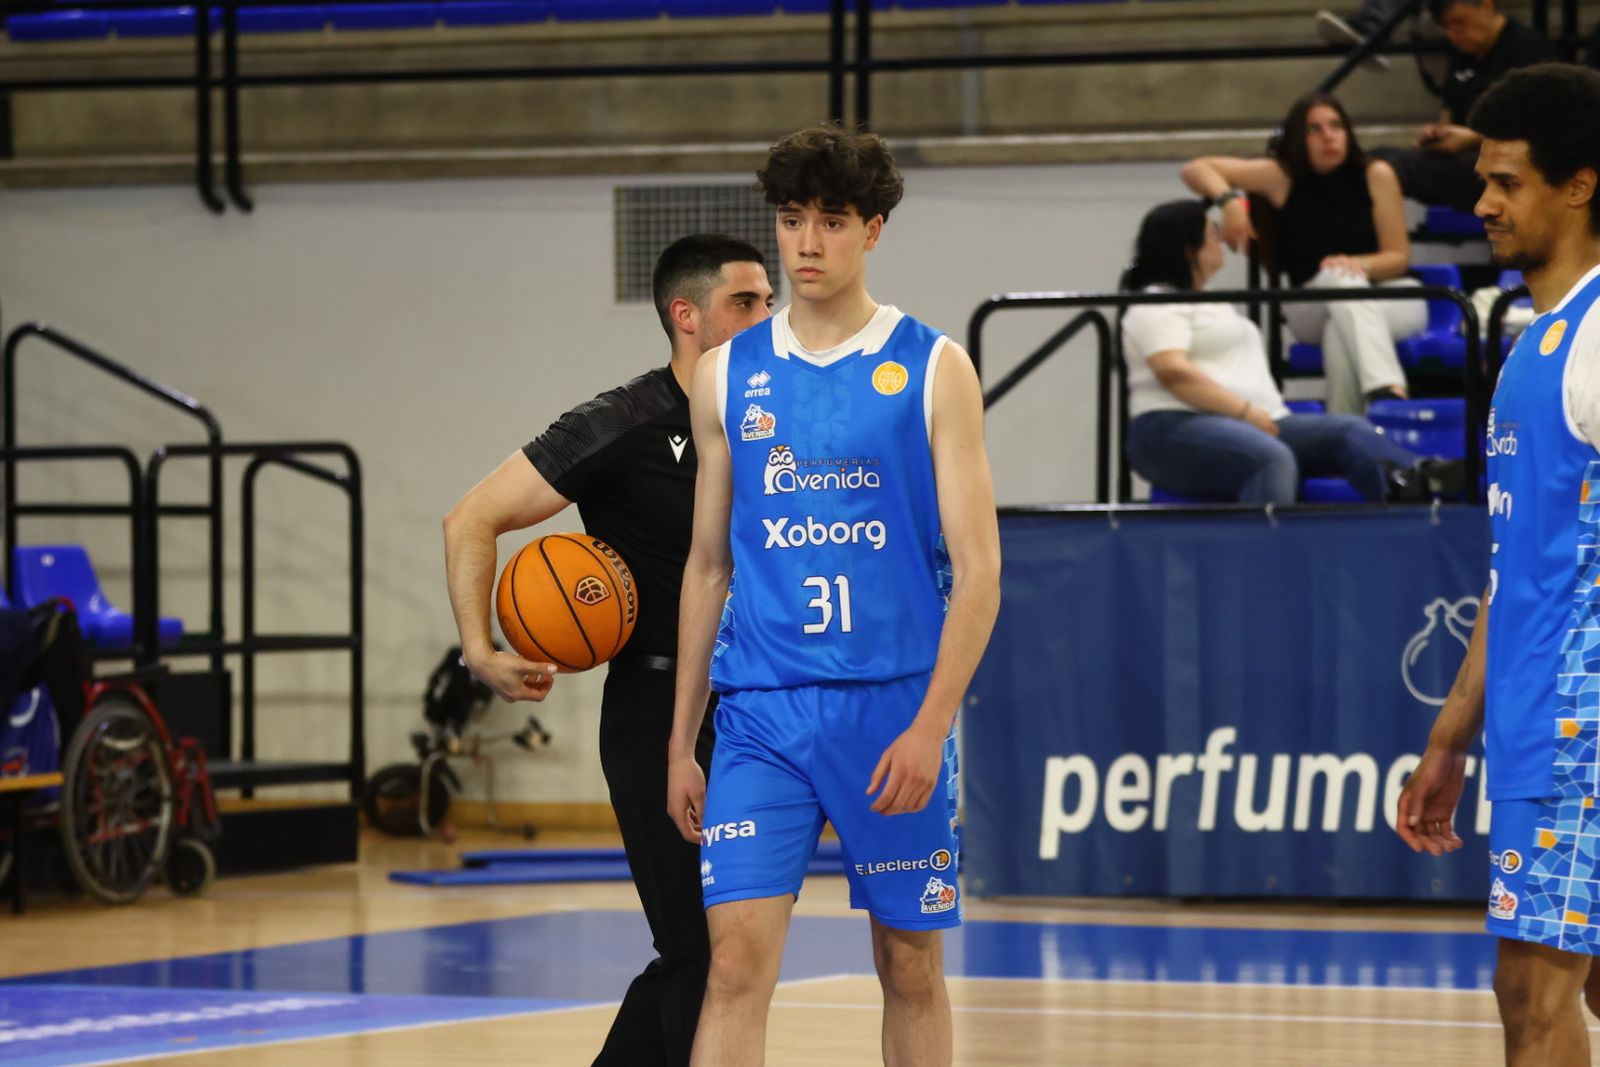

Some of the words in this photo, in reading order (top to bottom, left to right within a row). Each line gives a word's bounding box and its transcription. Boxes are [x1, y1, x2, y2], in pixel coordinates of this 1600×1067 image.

[761, 515, 887, 550] Xoborg
[801, 574, 852, 634] 31
[1039, 726, 1492, 860] perfumei
[854, 859, 929, 876] E.Leclerc
